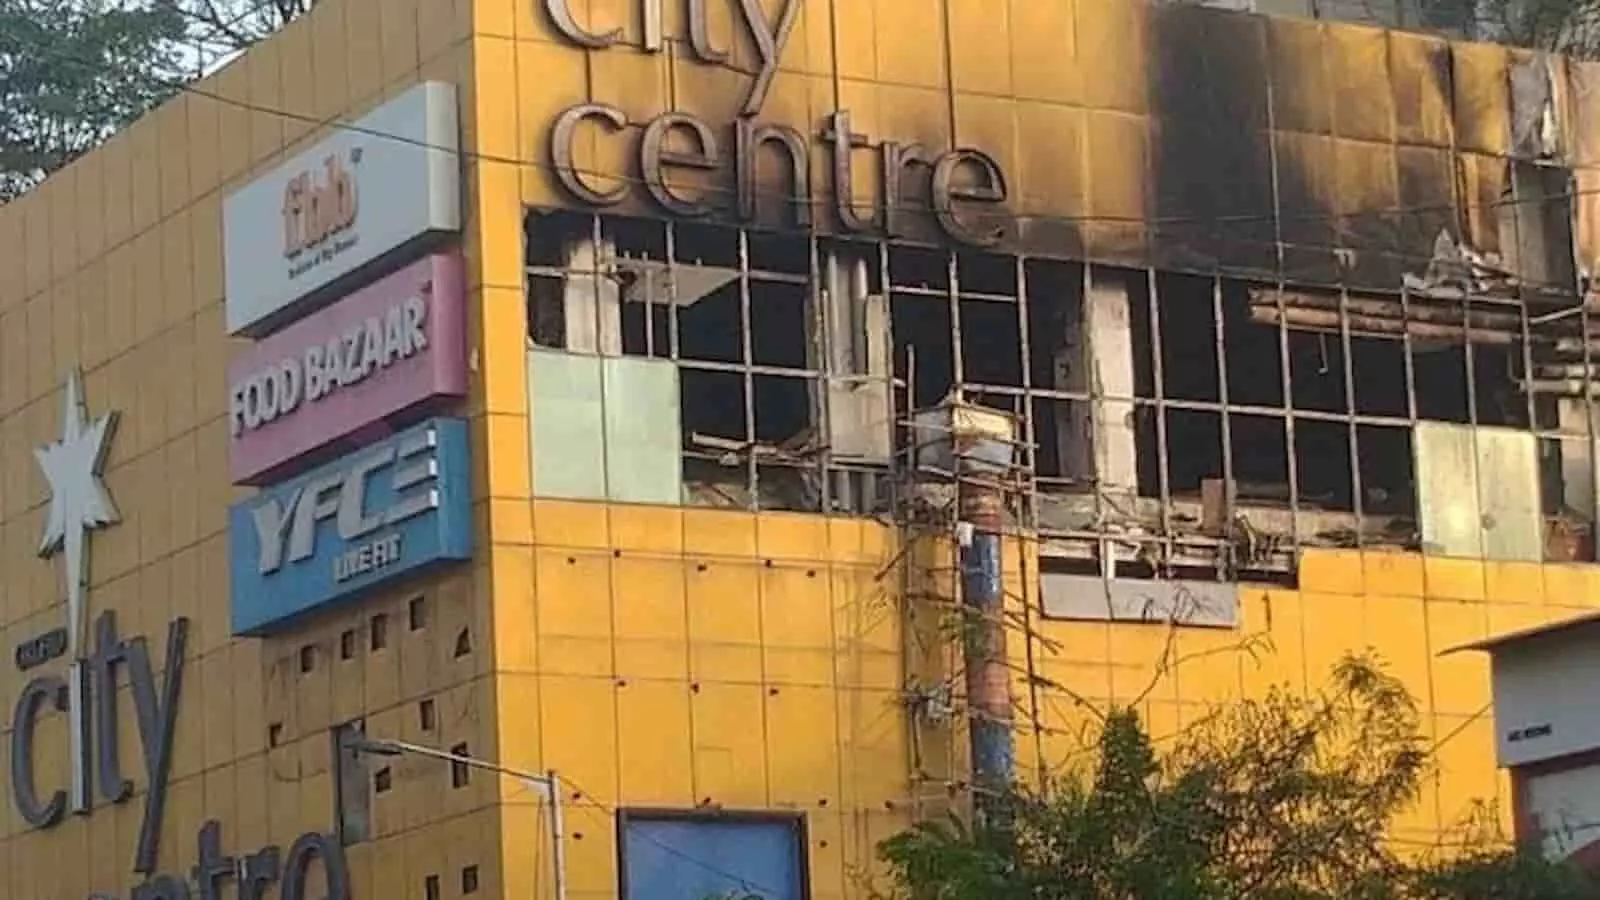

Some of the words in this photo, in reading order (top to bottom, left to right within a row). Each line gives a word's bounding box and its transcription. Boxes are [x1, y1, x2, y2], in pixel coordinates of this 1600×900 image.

[550, 101, 1006, 248] centre
[231, 357, 301, 438] FOOD
[304, 296, 428, 401] BAZAAR
[12, 609, 189, 874] city
